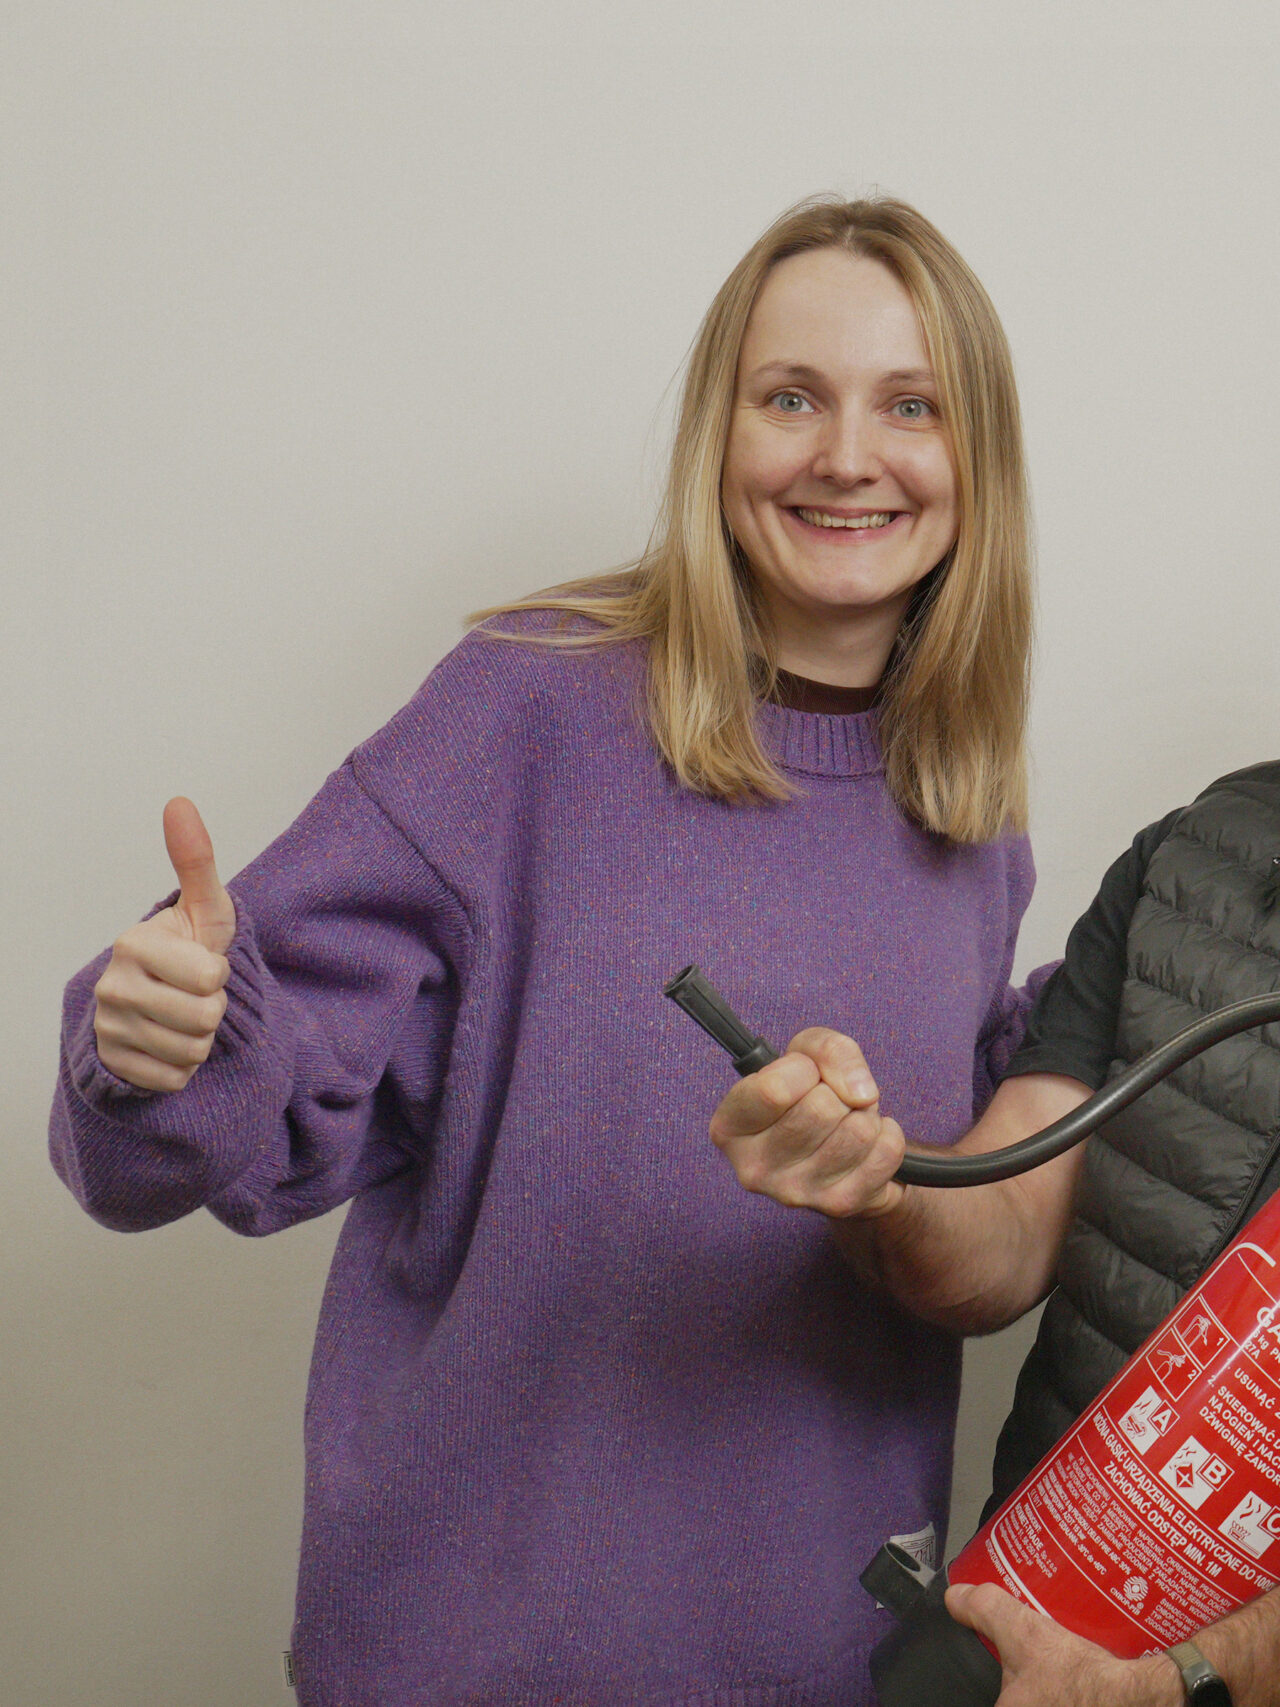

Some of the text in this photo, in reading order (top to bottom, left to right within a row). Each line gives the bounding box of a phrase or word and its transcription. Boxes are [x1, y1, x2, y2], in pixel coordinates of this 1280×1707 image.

[1217, 1338, 1224, 1346] 1
[1258, 1335, 1269, 1350] kg
[1188, 1370, 1197, 1379] 2
[1234, 1368, 1275, 1408] USUNĄĆ
[1152, 1409, 1172, 1432] A
[1199, 1406, 1247, 1456] DŹWIGNIĘ
[1208, 1375, 1217, 1387] 2.
[1218, 1386, 1275, 1442] SKIEROWAĆ
[1208, 1395, 1223, 1413] NA
[1222, 1410, 1257, 1441] OGIEŃ
[1253, 1439, 1259, 1447] I
[1203, 1458, 1226, 1484] B
[1014, 1502, 1044, 1551] BOXMET-TRADE
[1062, 1510, 1075, 1526] AZOT
[1072, 1523, 1080, 1533] 15
[1076, 1529, 1087, 1540] bar
[1104, 1461, 1222, 1577] ZACHOWAĆ ODSTĘP MIN. 1M
[1106, 1434, 1129, 1462] GASIĆ
[1123, 1457, 1175, 1516] URZĄDZENIA
[1172, 1510, 1242, 1570] ELEKTRYCZNE
[1238, 1564, 1256, 1580] DO
[1071, 1507, 1090, 1531] PROSZKU
[1098, 1540, 1112, 1555] FIRE
[1108, 1551, 1121, 1564] ABC
[1118, 1560, 1132, 1576] 30%
[1091, 1490, 1101, 1501] CO
[1132, 1535, 1174, 1575] KONSERWACJE
[1178, 1576, 1208, 1600] NAPRAWY
[1096, 1521, 1124, 1551] ZAMIENNE
[1122, 1548, 1149, 1574] ZGODNIE
[1147, 1572, 1156, 1580] Z
[1154, 1577, 1189, 1608] PRZYJĘTYM
[1110, 1499, 1138, 1530] PONOWNIE
[1166, 1556, 1200, 1585] OKRESOWE
[1199, 1582, 1232, 1608] PRZEGLĄDY
[1117, 1531, 1154, 1568] PRODUCENTA
[1152, 1565, 1188, 1596] ZAKŁADACH
